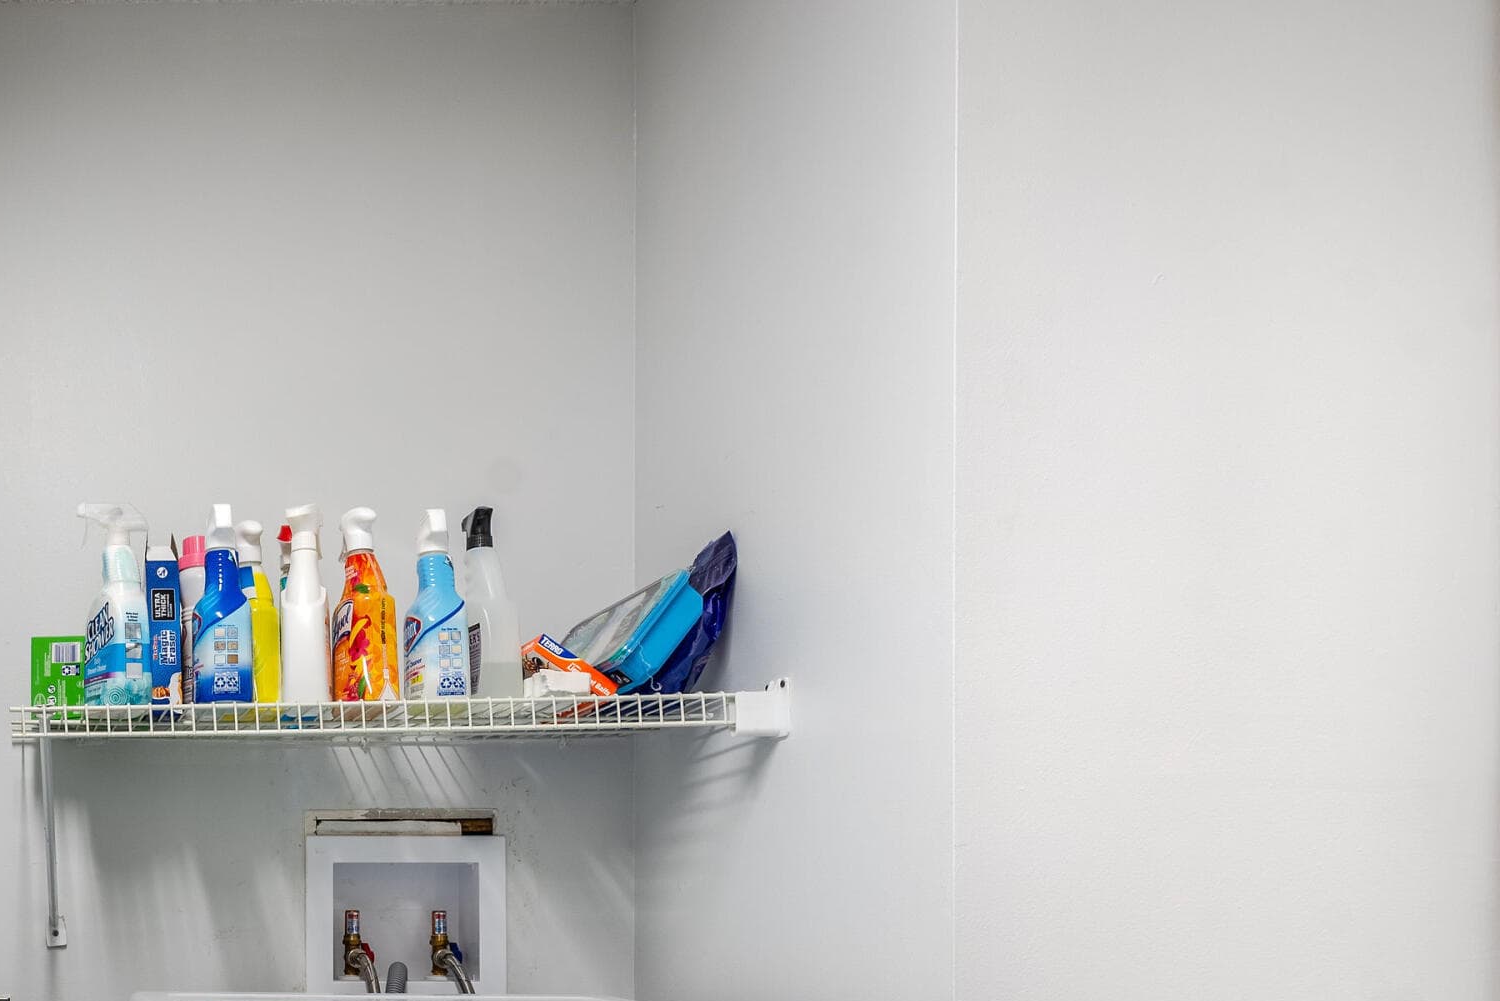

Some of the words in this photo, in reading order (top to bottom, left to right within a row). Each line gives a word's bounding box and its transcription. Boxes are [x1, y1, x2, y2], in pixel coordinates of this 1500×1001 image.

[87, 601, 109, 641] CLEAN
[160, 631, 169, 665] Magic
[168, 631, 177, 665] Eraser
[541, 636, 564, 655] TERRO
[595, 683, 611, 697] Baits
